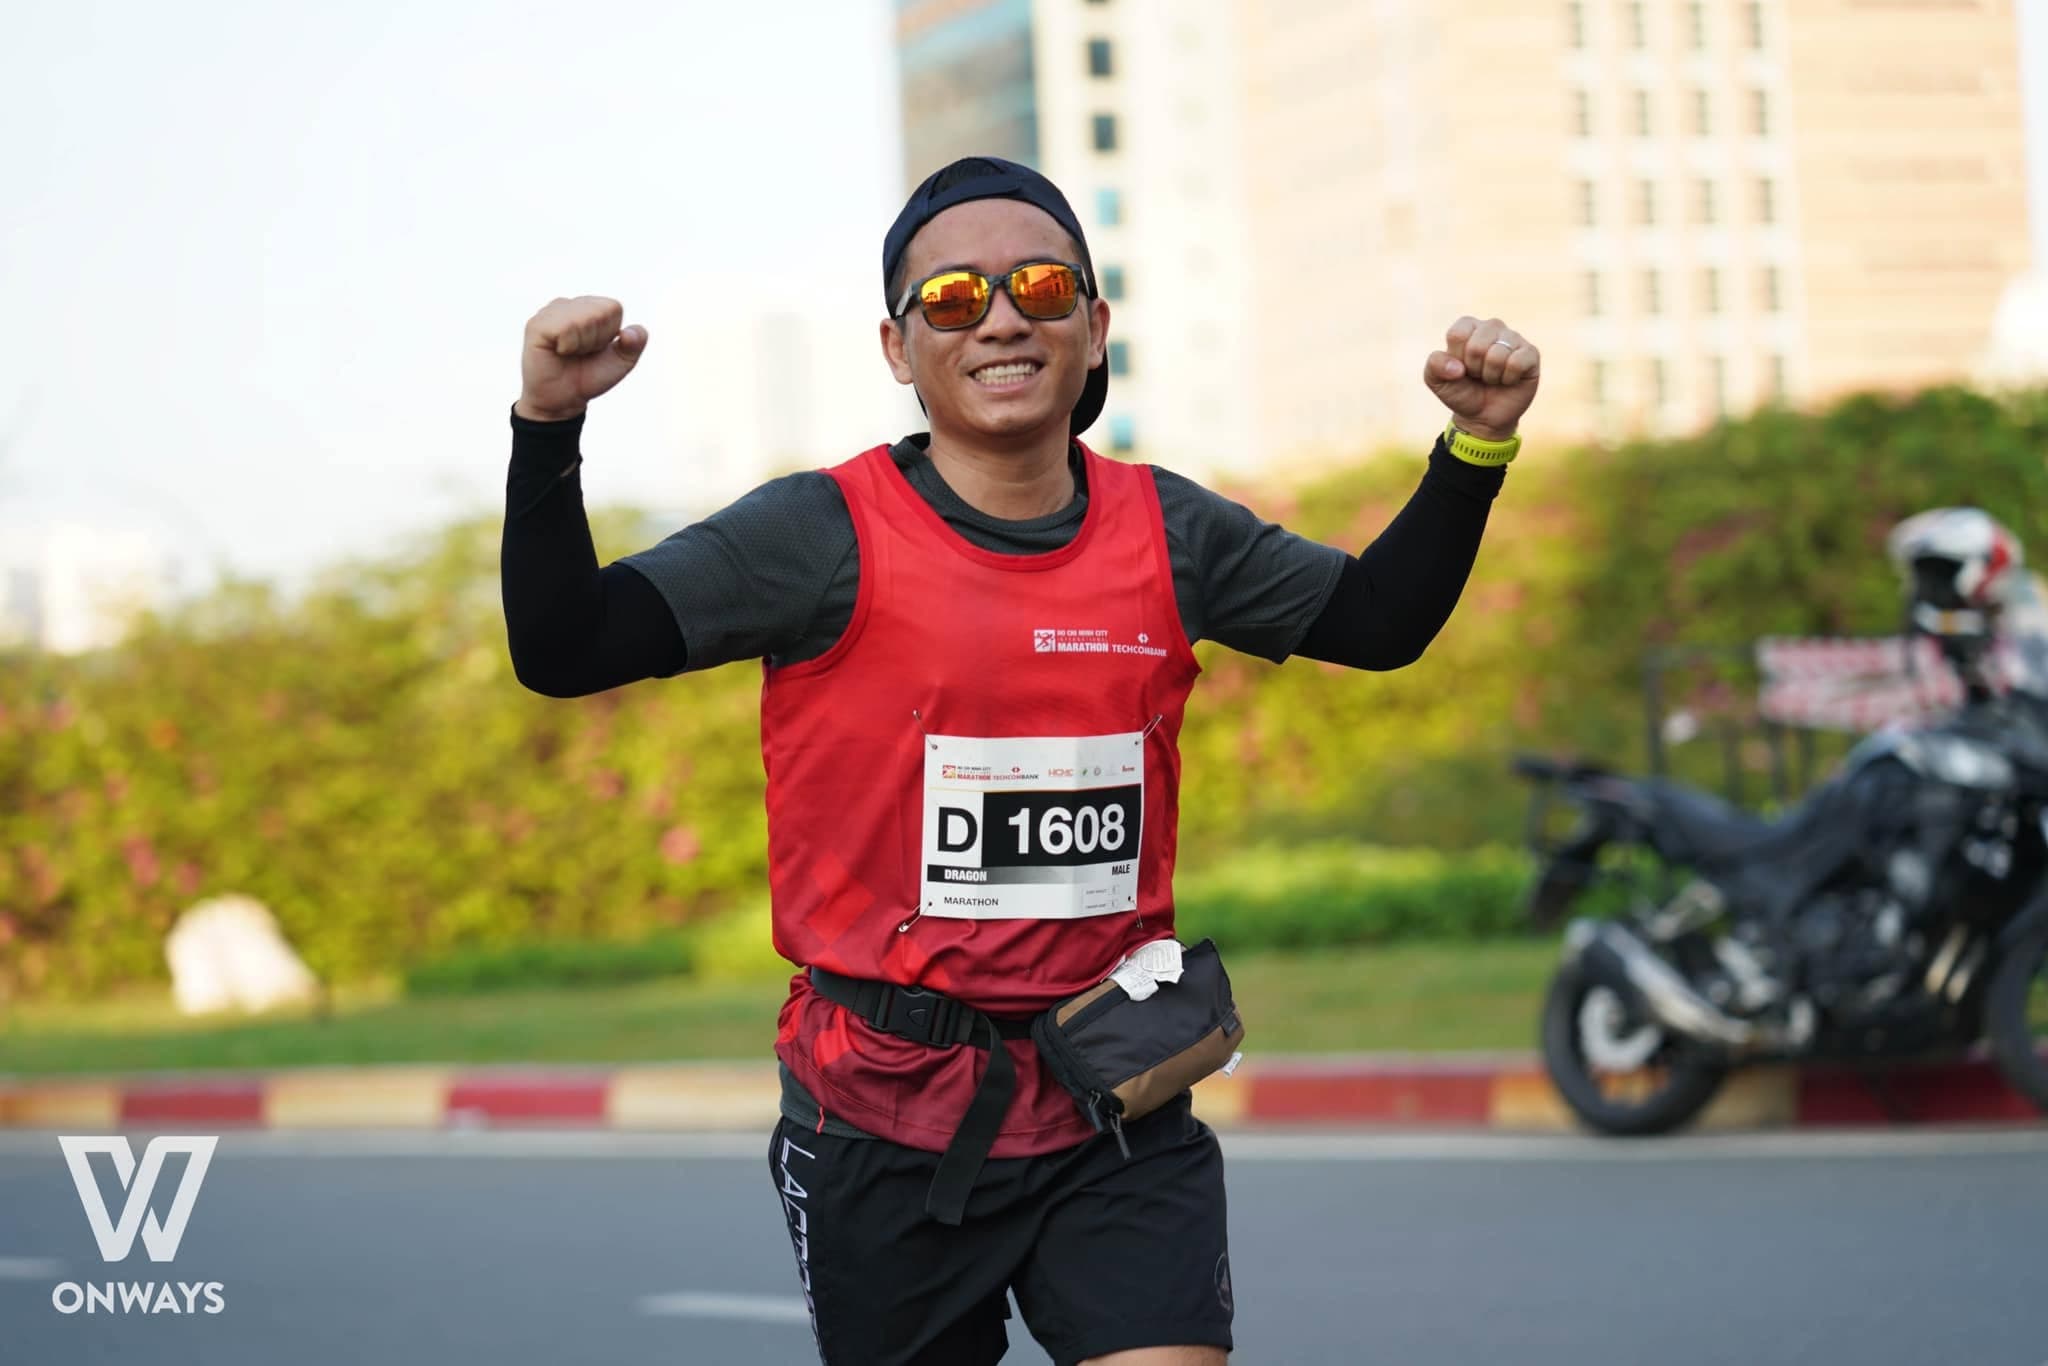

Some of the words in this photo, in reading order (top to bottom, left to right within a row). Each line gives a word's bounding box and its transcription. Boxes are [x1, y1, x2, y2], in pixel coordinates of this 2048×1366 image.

[1057, 642, 1109, 653] MARATHON
[1111, 644, 1167, 657] TECHCOMBANK
[937, 806, 978, 853] D
[1008, 803, 1125, 855] 1608
[944, 869, 987, 882] DRAGON
[1111, 864, 1131, 876] MALE
[943, 896, 999, 906] MARATHON
